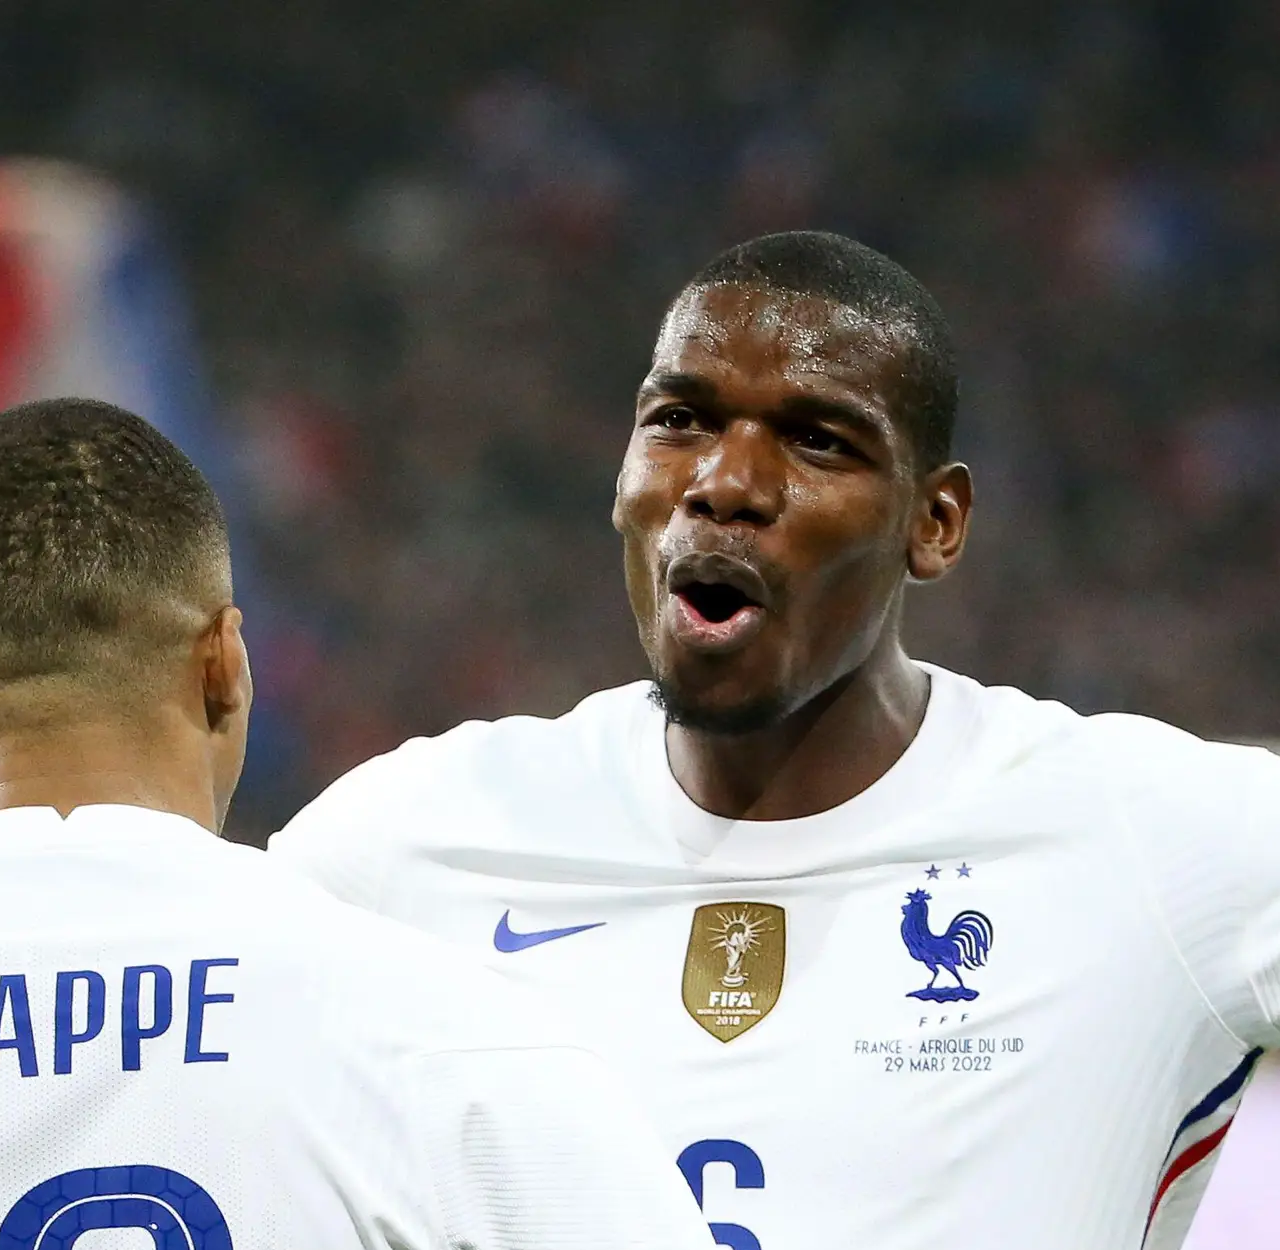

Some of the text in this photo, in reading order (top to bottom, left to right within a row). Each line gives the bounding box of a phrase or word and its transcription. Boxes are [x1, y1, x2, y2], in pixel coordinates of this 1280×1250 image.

[708, 991, 753, 1008] FIFA
[715, 1016, 741, 1026] 2018
[854, 1039, 902, 1055] FRANCE
[919, 1038, 973, 1055] AFRIQUE
[978, 1038, 996, 1053] DU
[1000, 1037, 1025, 1053] SUD
[884, 1056, 993, 1073] 29 MARS 2022
